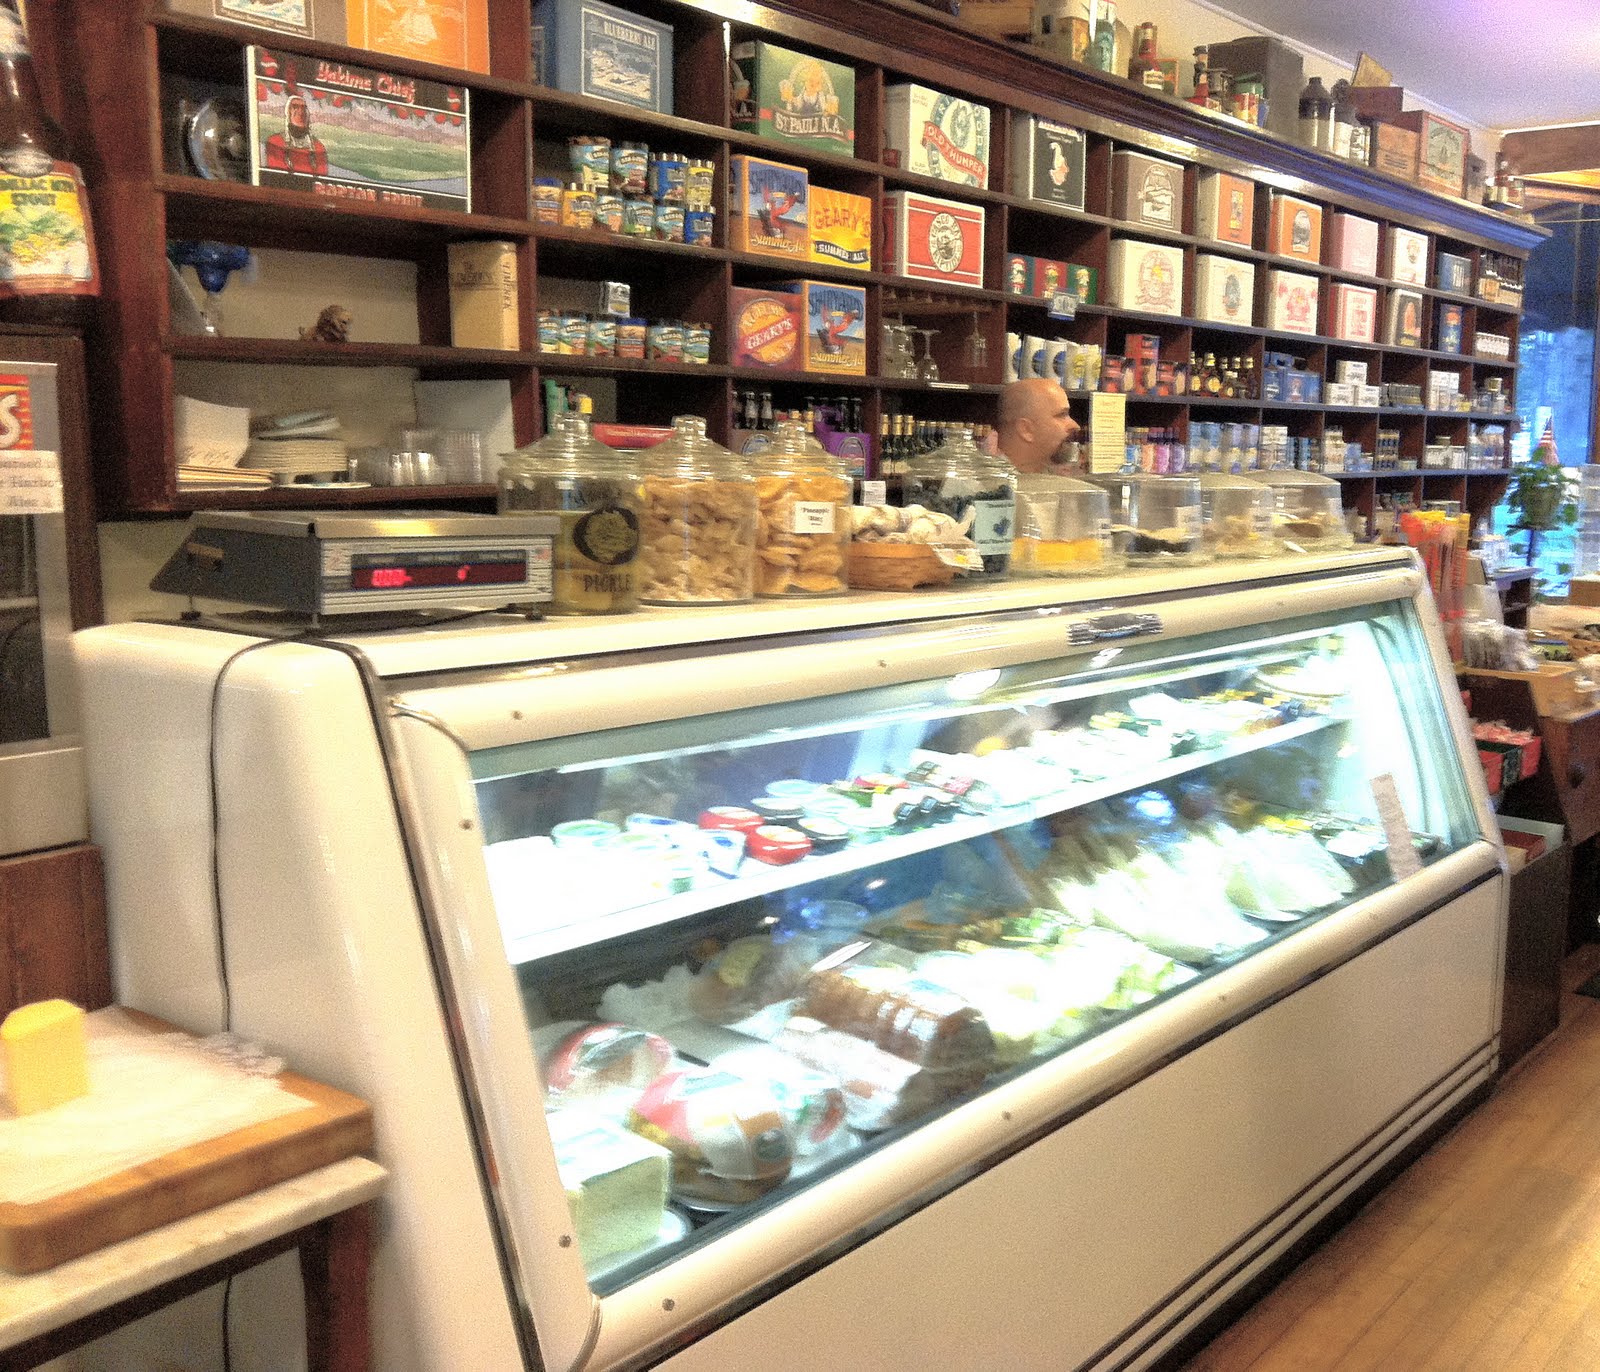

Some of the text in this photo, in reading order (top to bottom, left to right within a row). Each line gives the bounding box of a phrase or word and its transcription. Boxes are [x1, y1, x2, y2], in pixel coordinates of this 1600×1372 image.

[789, 116, 819, 134] PAULI
[928, 125, 945, 145] OLD
[945, 145, 985, 176] THUMPER
[818, 244, 850, 261] SUMMER
